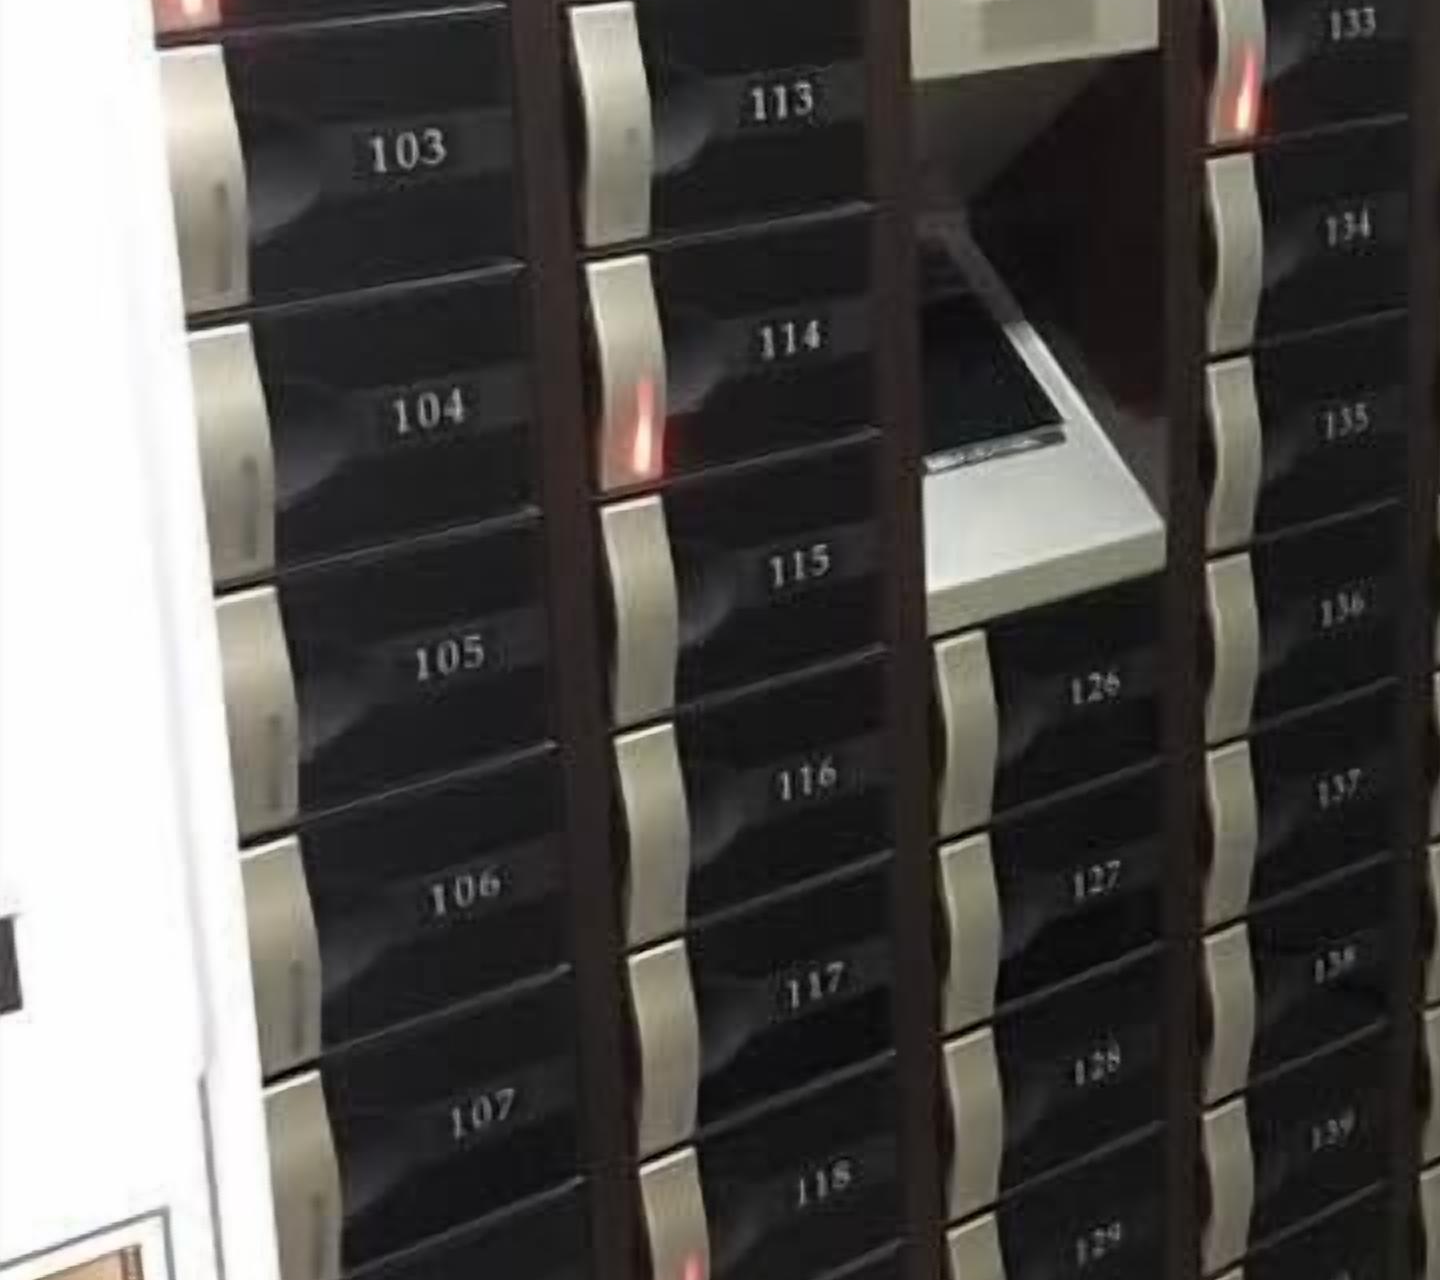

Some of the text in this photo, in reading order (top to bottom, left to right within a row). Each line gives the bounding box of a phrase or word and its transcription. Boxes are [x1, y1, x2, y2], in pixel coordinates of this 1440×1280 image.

[1330, 5, 1377, 41] 133
[751, 81, 814, 121] 113
[370, 128, 447, 173] 103
[1326, 208, 1371, 246] 134
[761, 319, 821, 359] 114
[394, 388, 465, 434] 104
[1325, 403, 1370, 440] 135
[770, 543, 830, 587] 115
[415, 633, 485, 681] 105
[1071, 671, 1121, 706] 126
[779, 760, 837, 801] 116
[431, 871, 501, 916] 106
[1073, 859, 1122, 901] 127
[787, 960, 845, 1009] 117
[451, 1087, 516, 1140] 107
[798, 1161, 852, 1207] 118
